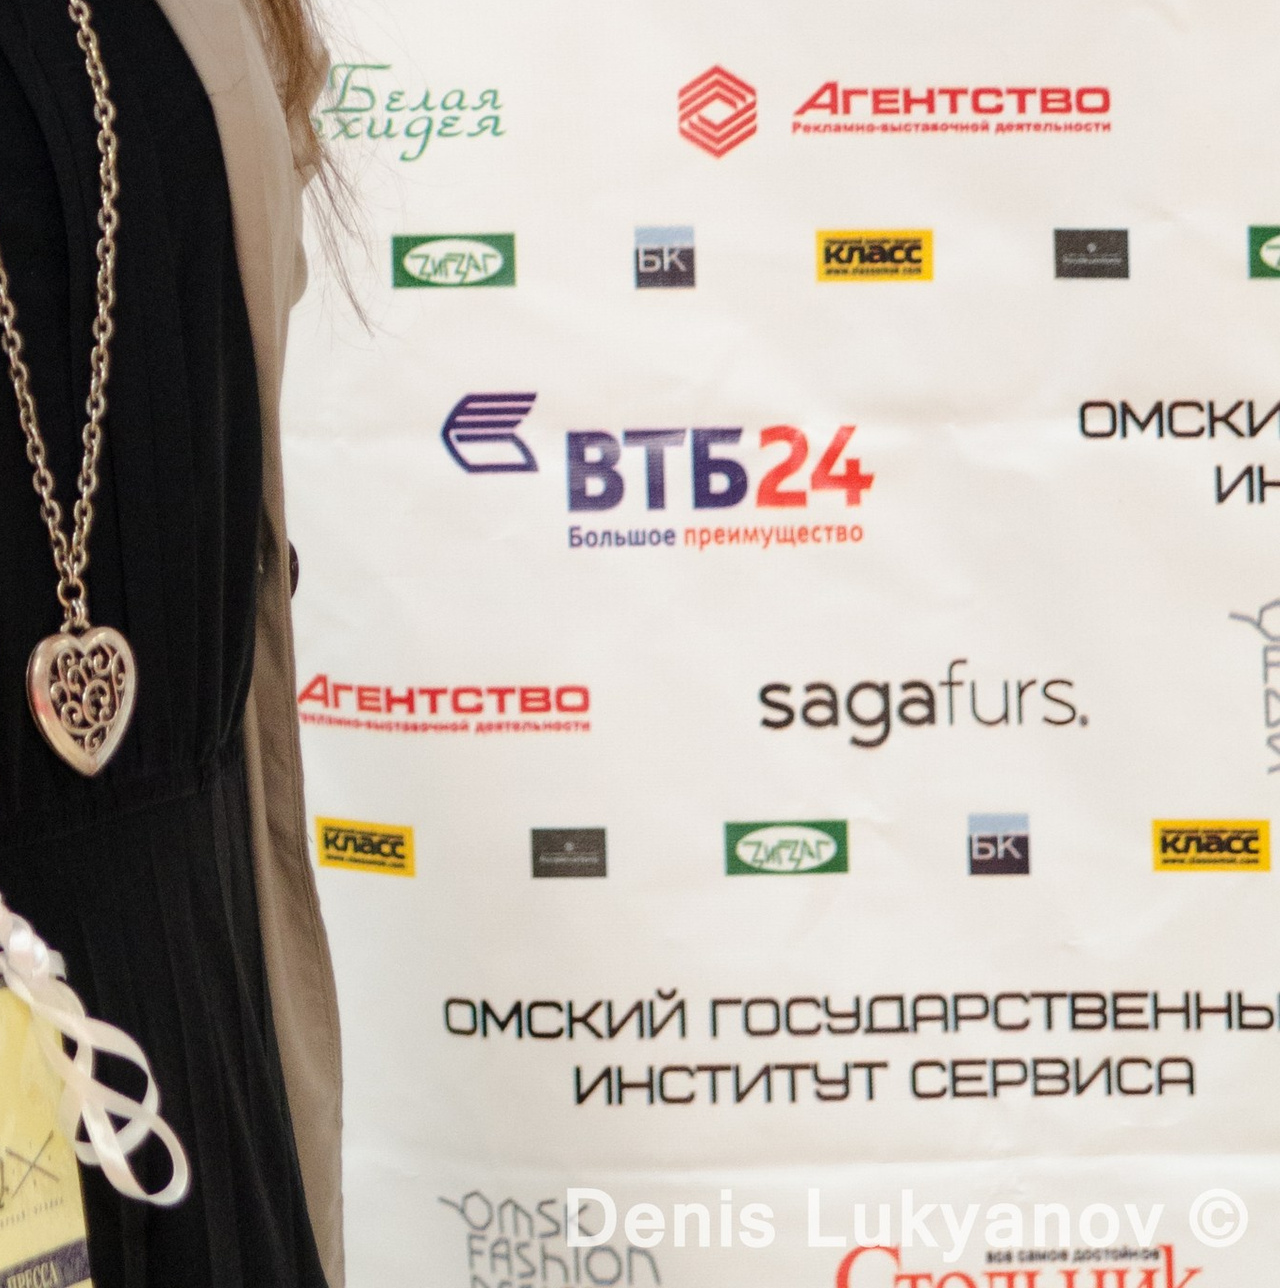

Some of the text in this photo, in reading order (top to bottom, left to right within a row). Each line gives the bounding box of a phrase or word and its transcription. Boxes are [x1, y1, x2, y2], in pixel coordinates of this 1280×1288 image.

[321, 63, 504, 118] Белая
[638, 249, 686, 274] БК
[566, 425, 874, 512] ВТБ24
[568, 525, 864, 551] Большое преимущество
[973, 836, 1021, 861] БК
[444, 989, 686, 1040] ОМСКИЙ
[574, 1057, 1194, 1106] ИНСТИТУТ СЕРВИСА
